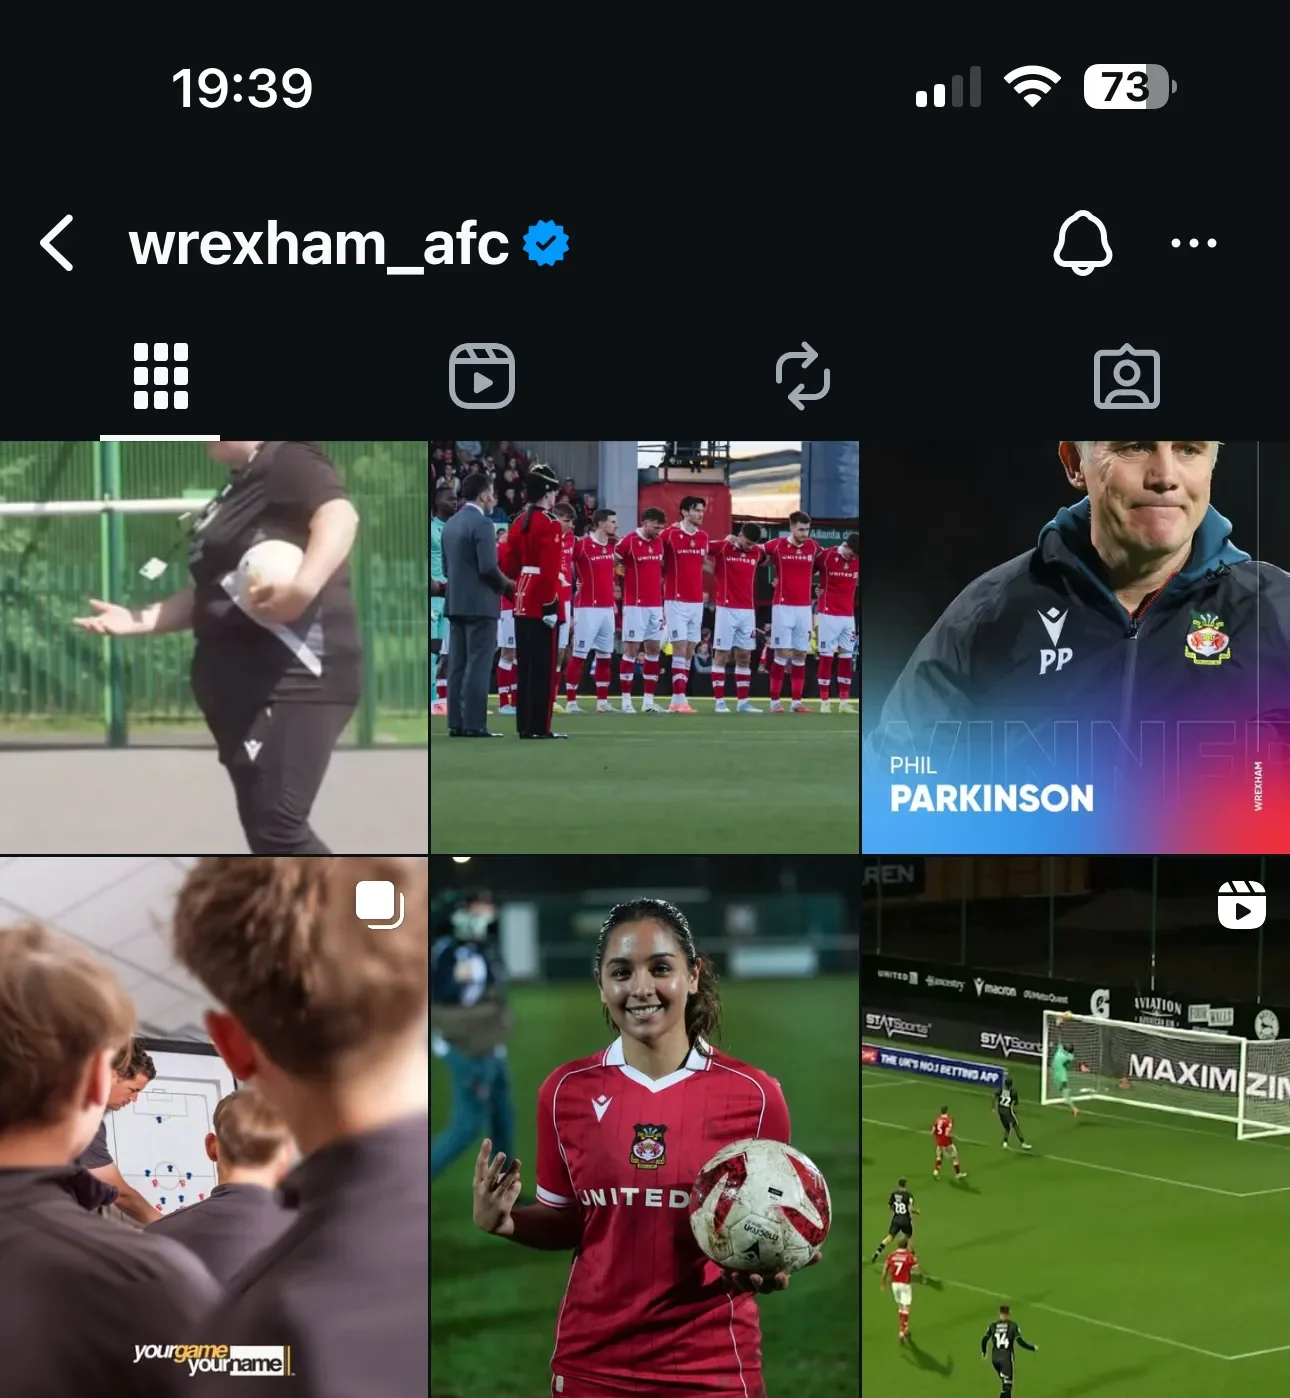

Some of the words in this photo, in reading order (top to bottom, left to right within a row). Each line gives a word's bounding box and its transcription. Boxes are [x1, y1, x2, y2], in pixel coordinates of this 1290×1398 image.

[173, 68, 312, 108] 19:39
[1101, 70, 1151, 104] 73
[129, 220, 508, 275] wrexham_afc
[1039, 647, 1073, 675] PP
[890, 756, 938, 775] PHIL
[1254, 761, 1263, 812] WREXHAM
[890, 784, 1094, 813] PARKINSON
[984, 984, 1017, 997] macron
[1134, 997, 1182, 1016] AVIATION
[881, 1053, 898, 1065] THE
[894, 1262, 903, 1276] 7
[994, 1332, 1010, 1349] 14
